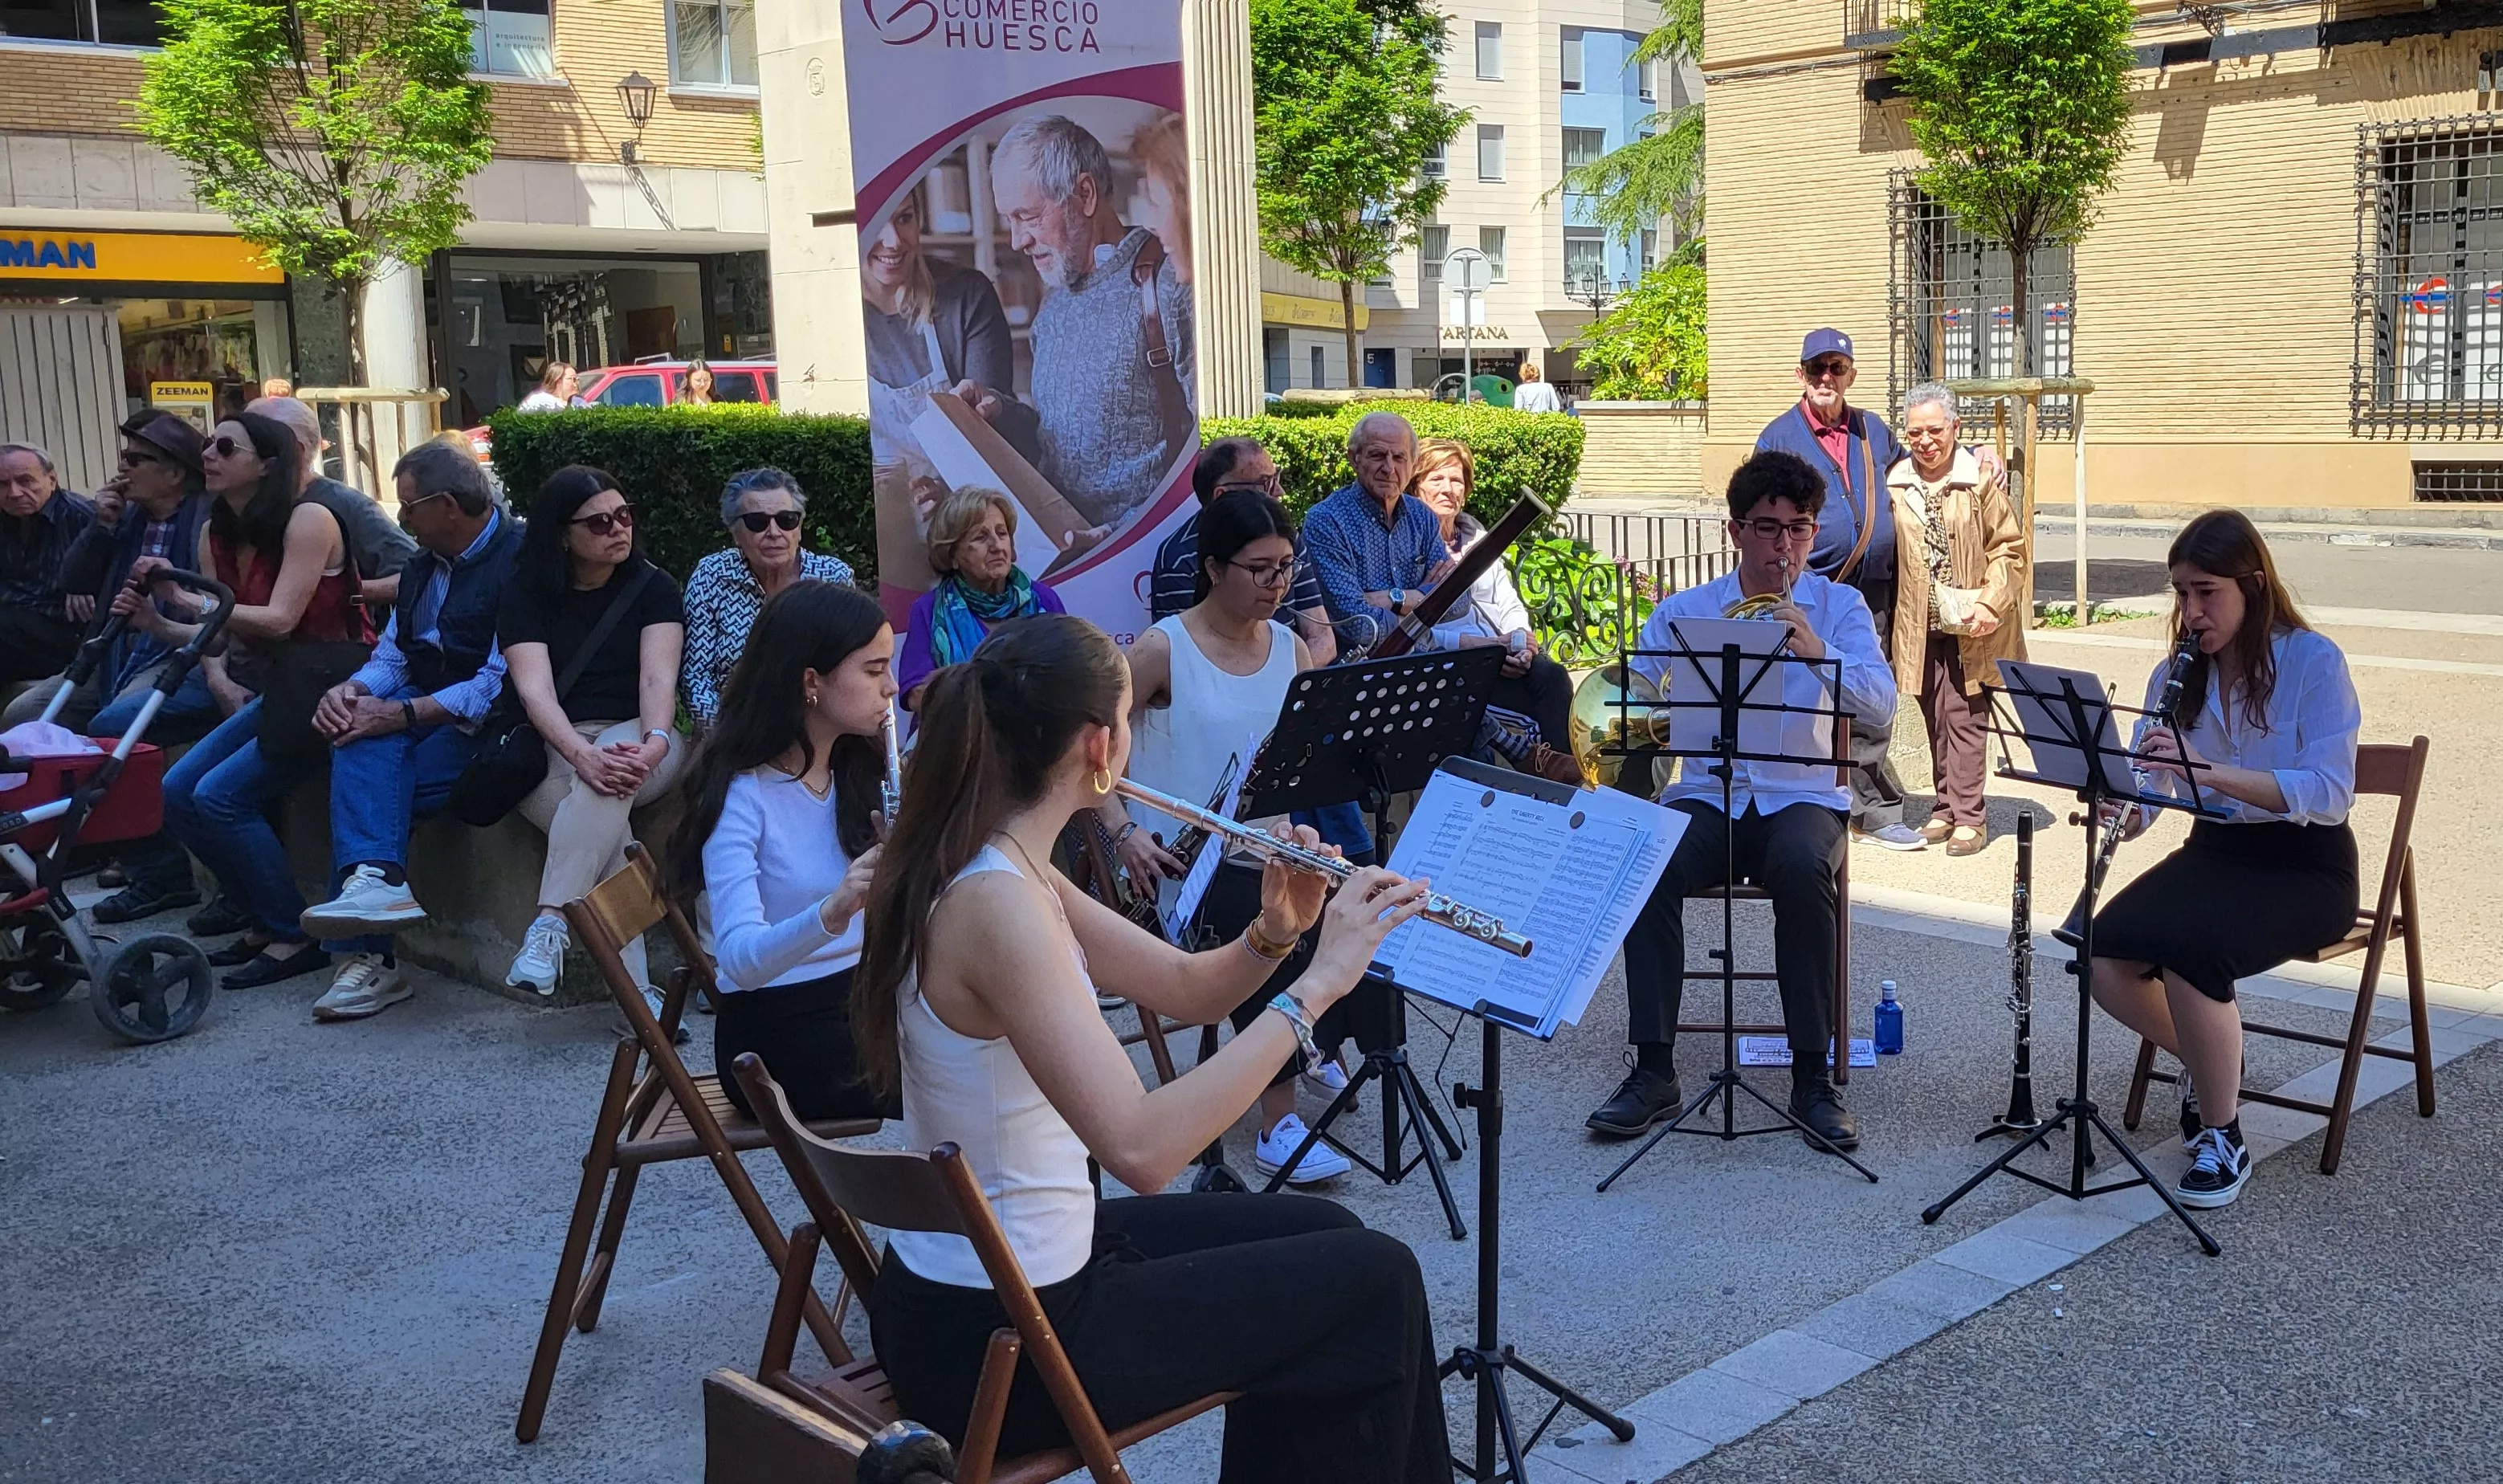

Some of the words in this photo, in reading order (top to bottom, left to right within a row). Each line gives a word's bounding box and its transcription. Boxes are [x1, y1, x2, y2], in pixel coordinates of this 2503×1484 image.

[944, 0, 1099, 25] COMERCIO
[495, 33, 545, 42] arquitectura
[944, 21, 1101, 53] HUESCA
[0, 239, 96, 268] MAN
[1367, 353, 1375, 365] 5
[156, 387, 209, 396] ZEEMAN
